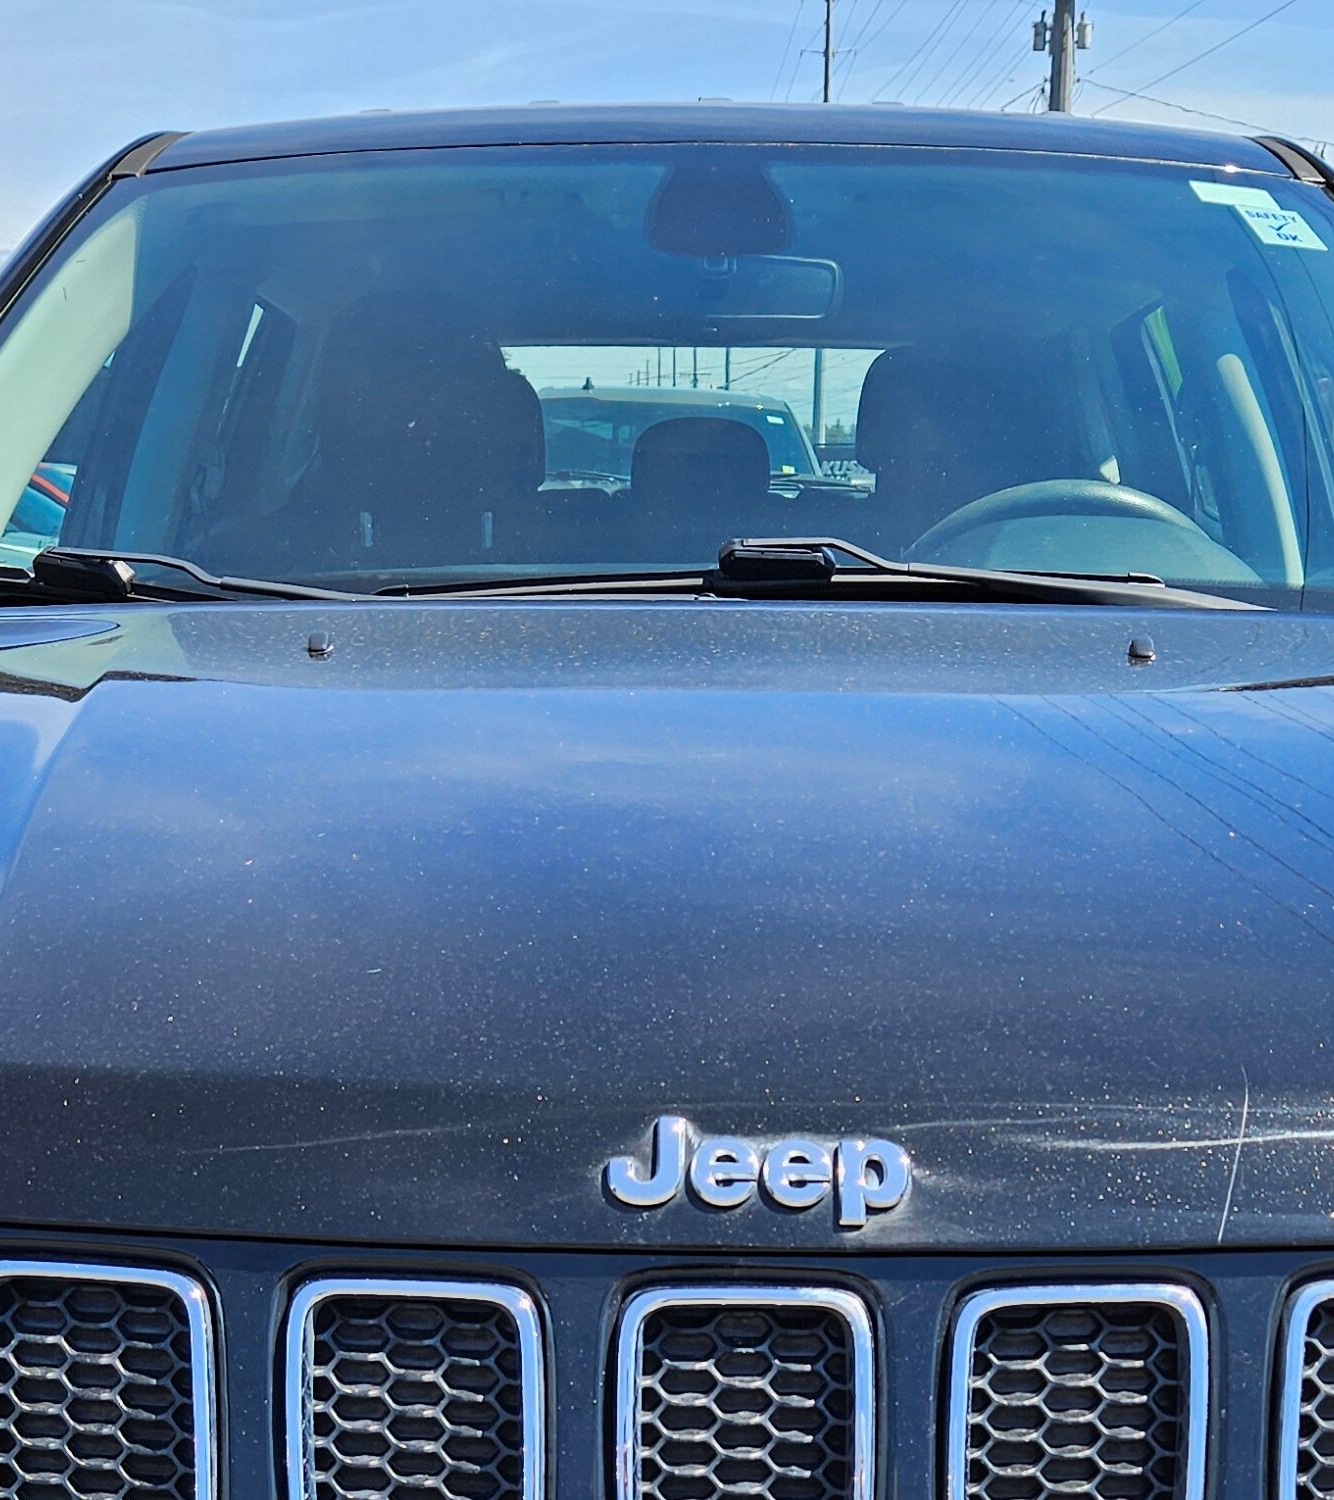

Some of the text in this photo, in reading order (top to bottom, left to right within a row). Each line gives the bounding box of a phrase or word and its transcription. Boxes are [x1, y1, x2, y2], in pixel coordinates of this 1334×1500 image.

[1276, 232, 1304, 242] OK
[820, 460, 869, 476] KUS
[602, 1116, 911, 1227] Jeep
